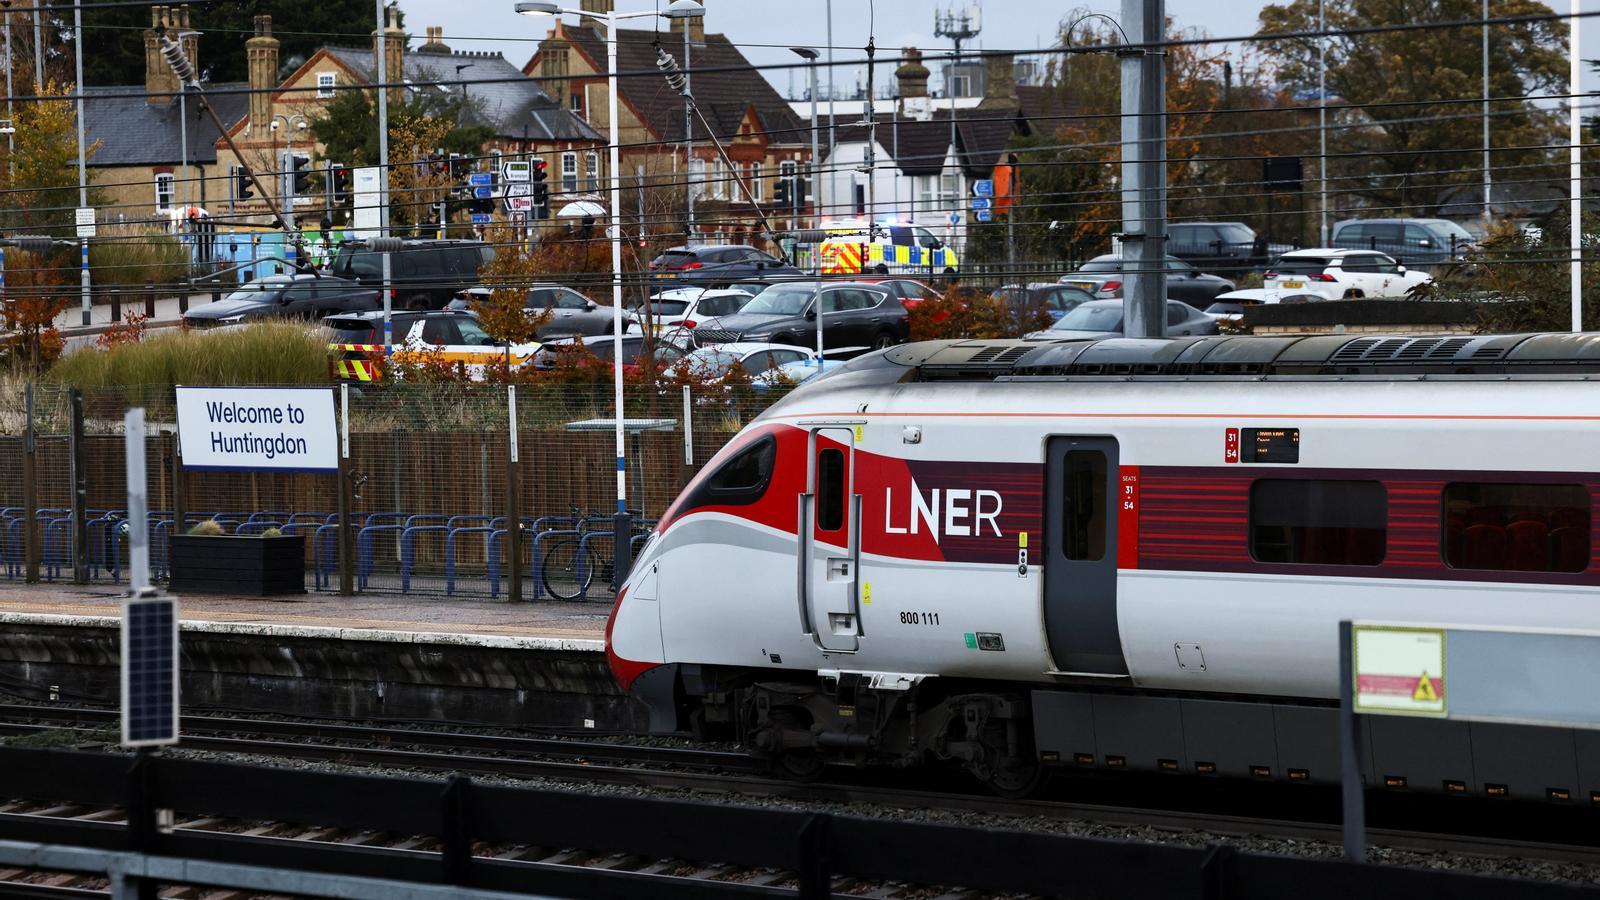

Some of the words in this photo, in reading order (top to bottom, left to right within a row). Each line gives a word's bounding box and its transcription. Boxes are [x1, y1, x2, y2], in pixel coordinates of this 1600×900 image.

[206, 401, 283, 424] Welcome
[287, 403, 305, 424] to
[1228, 433, 1236, 442] 31
[210, 431, 307, 459] Huntingdon
[1226, 449, 1237, 458] 54
[1125, 485, 1133, 494] 31
[885, 475, 1003, 546] LNER
[1124, 501, 1134, 510] 54
[899, 611, 919, 625] 800
[921, 612, 940, 626] 111
